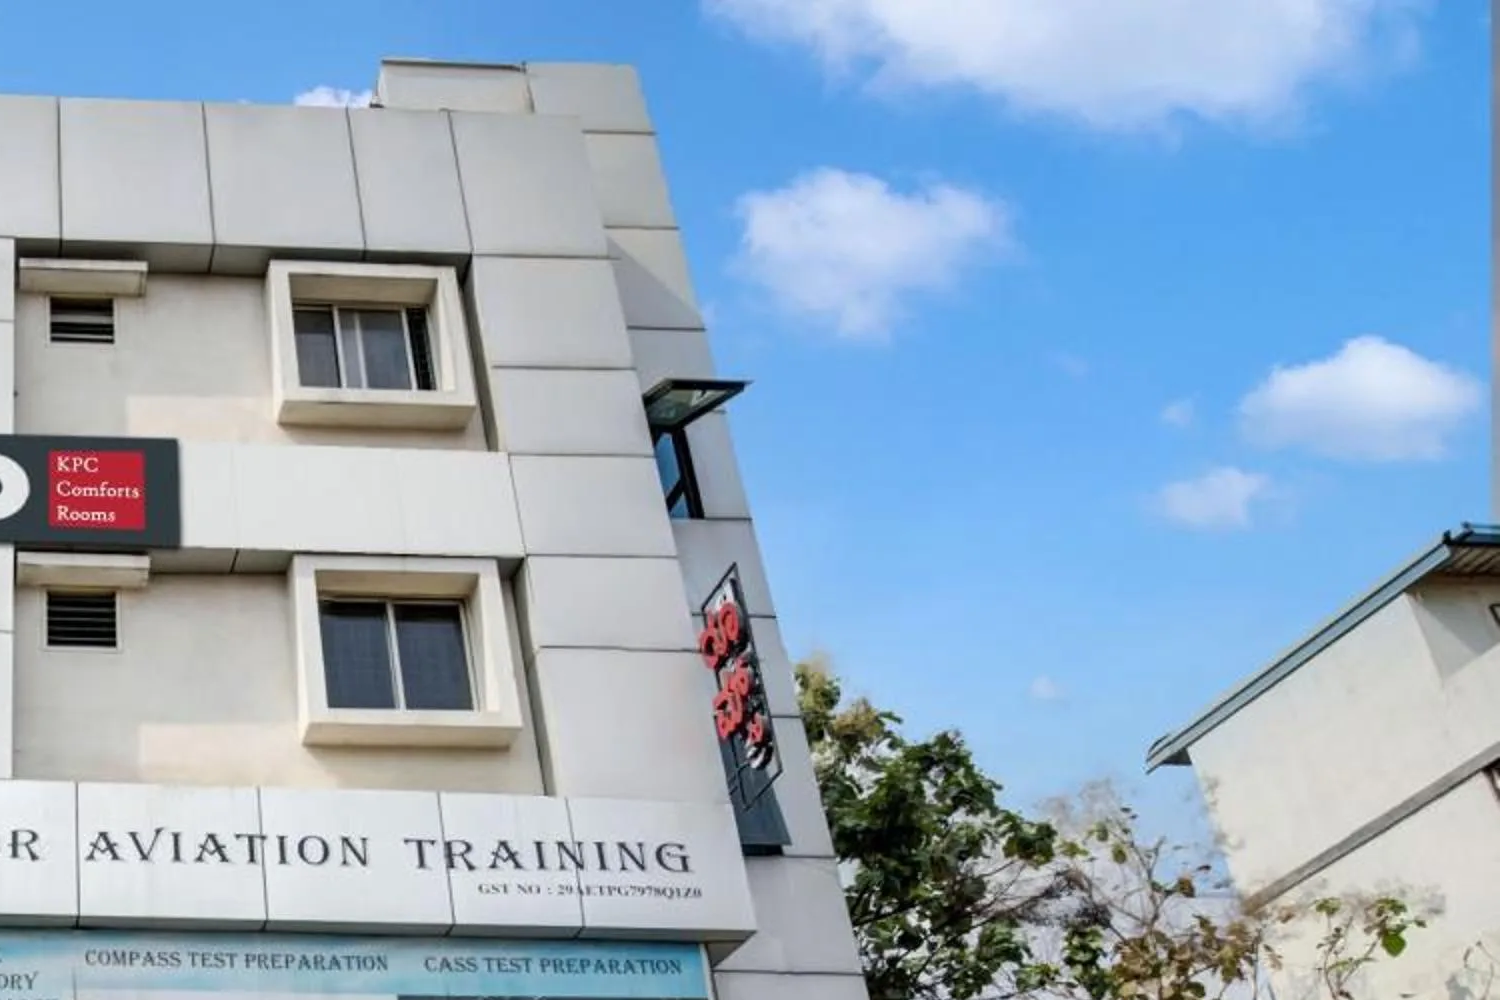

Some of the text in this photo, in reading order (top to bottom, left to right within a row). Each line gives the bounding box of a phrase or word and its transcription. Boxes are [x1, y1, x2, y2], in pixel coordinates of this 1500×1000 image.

[56, 457, 99, 473] KPC
[56, 481, 140, 498] Comforts
[56, 506, 116, 522] Rooms
[85, 826, 371, 868] AVIATION
[403, 837, 697, 874] TRAINING
[477, 883, 509, 895] GST
[84, 949, 389, 972] COMPASS TEST PREPARATION
[424, 956, 683, 975] CASS TEST PREPARATION
